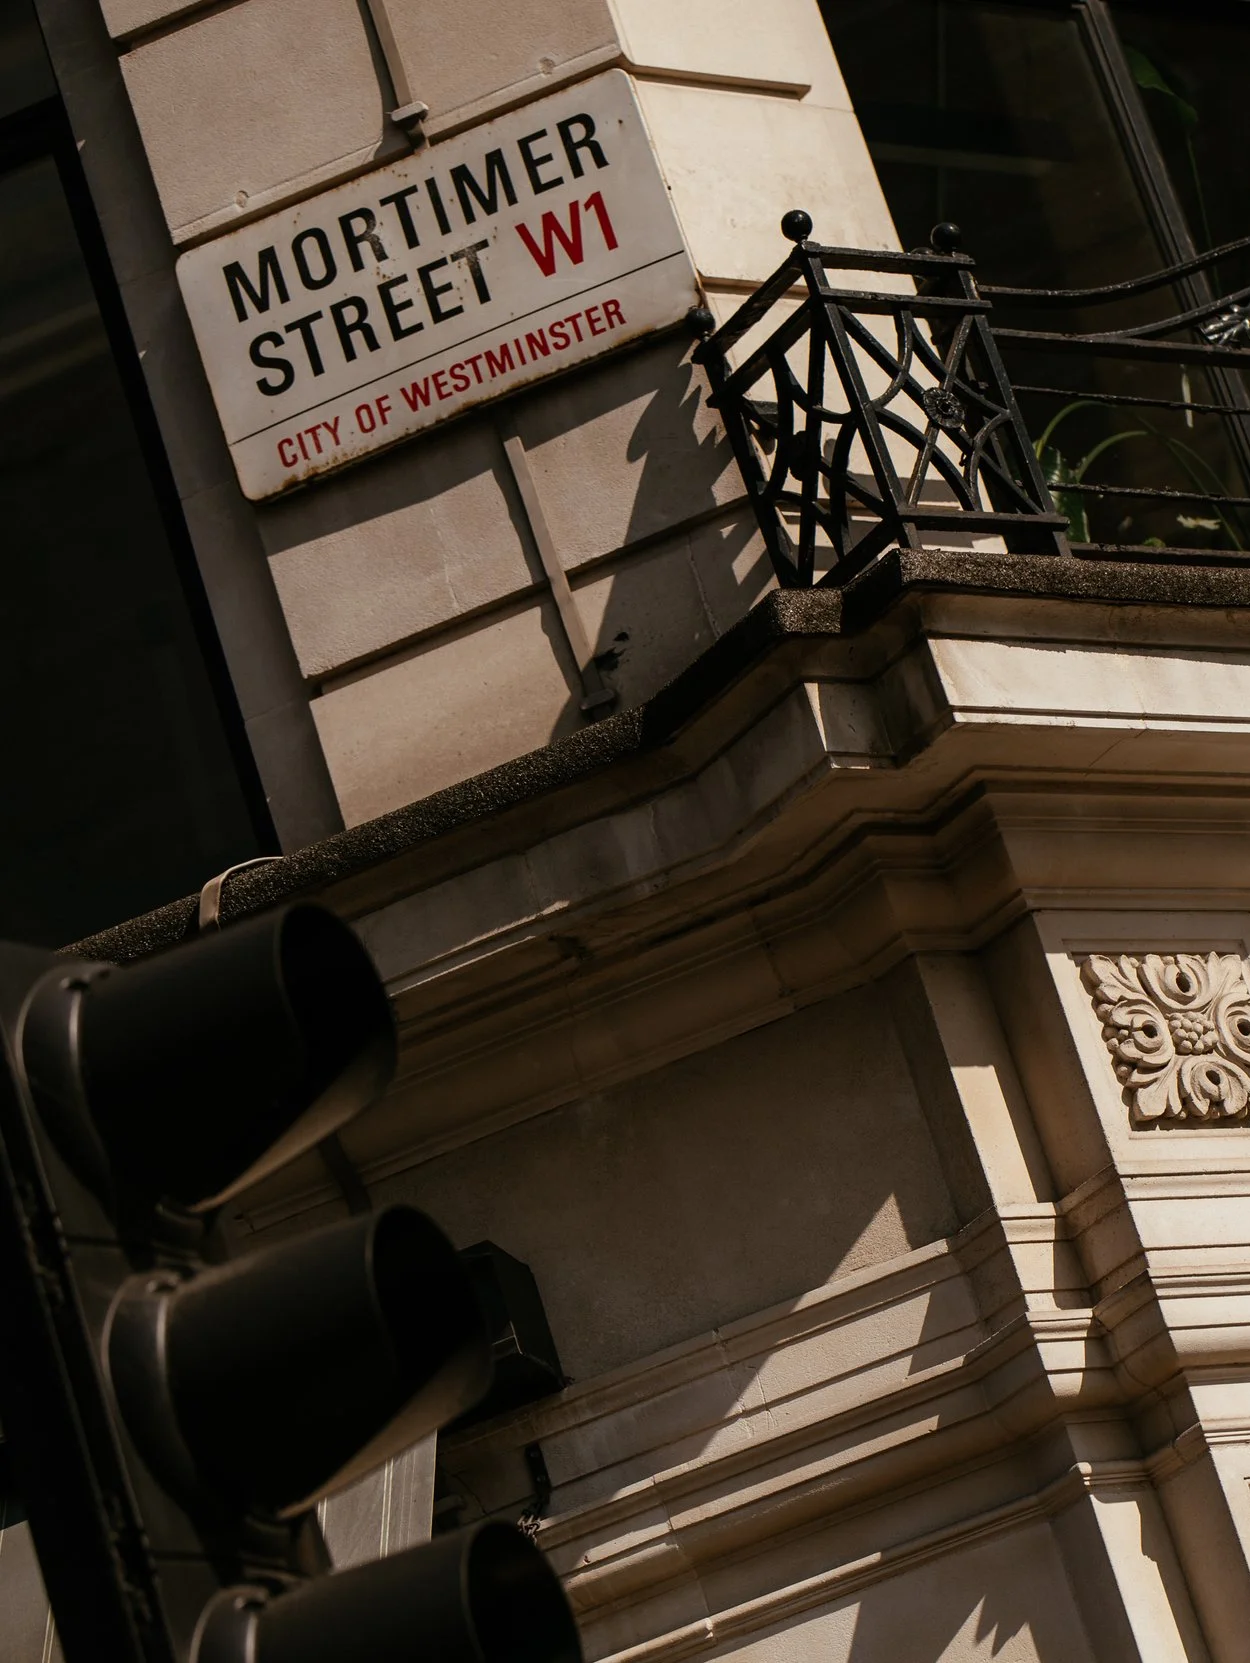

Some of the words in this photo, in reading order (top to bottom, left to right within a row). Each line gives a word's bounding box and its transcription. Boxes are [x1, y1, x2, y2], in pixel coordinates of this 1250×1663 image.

[222, 112, 609, 323] MORTIMER
[249, 239, 490, 397] STREET
[515, 191, 619, 277] W1
[278, 416, 341, 468] CITY
[356, 394, 392, 434] OF
[400, 298, 627, 414] WESTMINSTER
